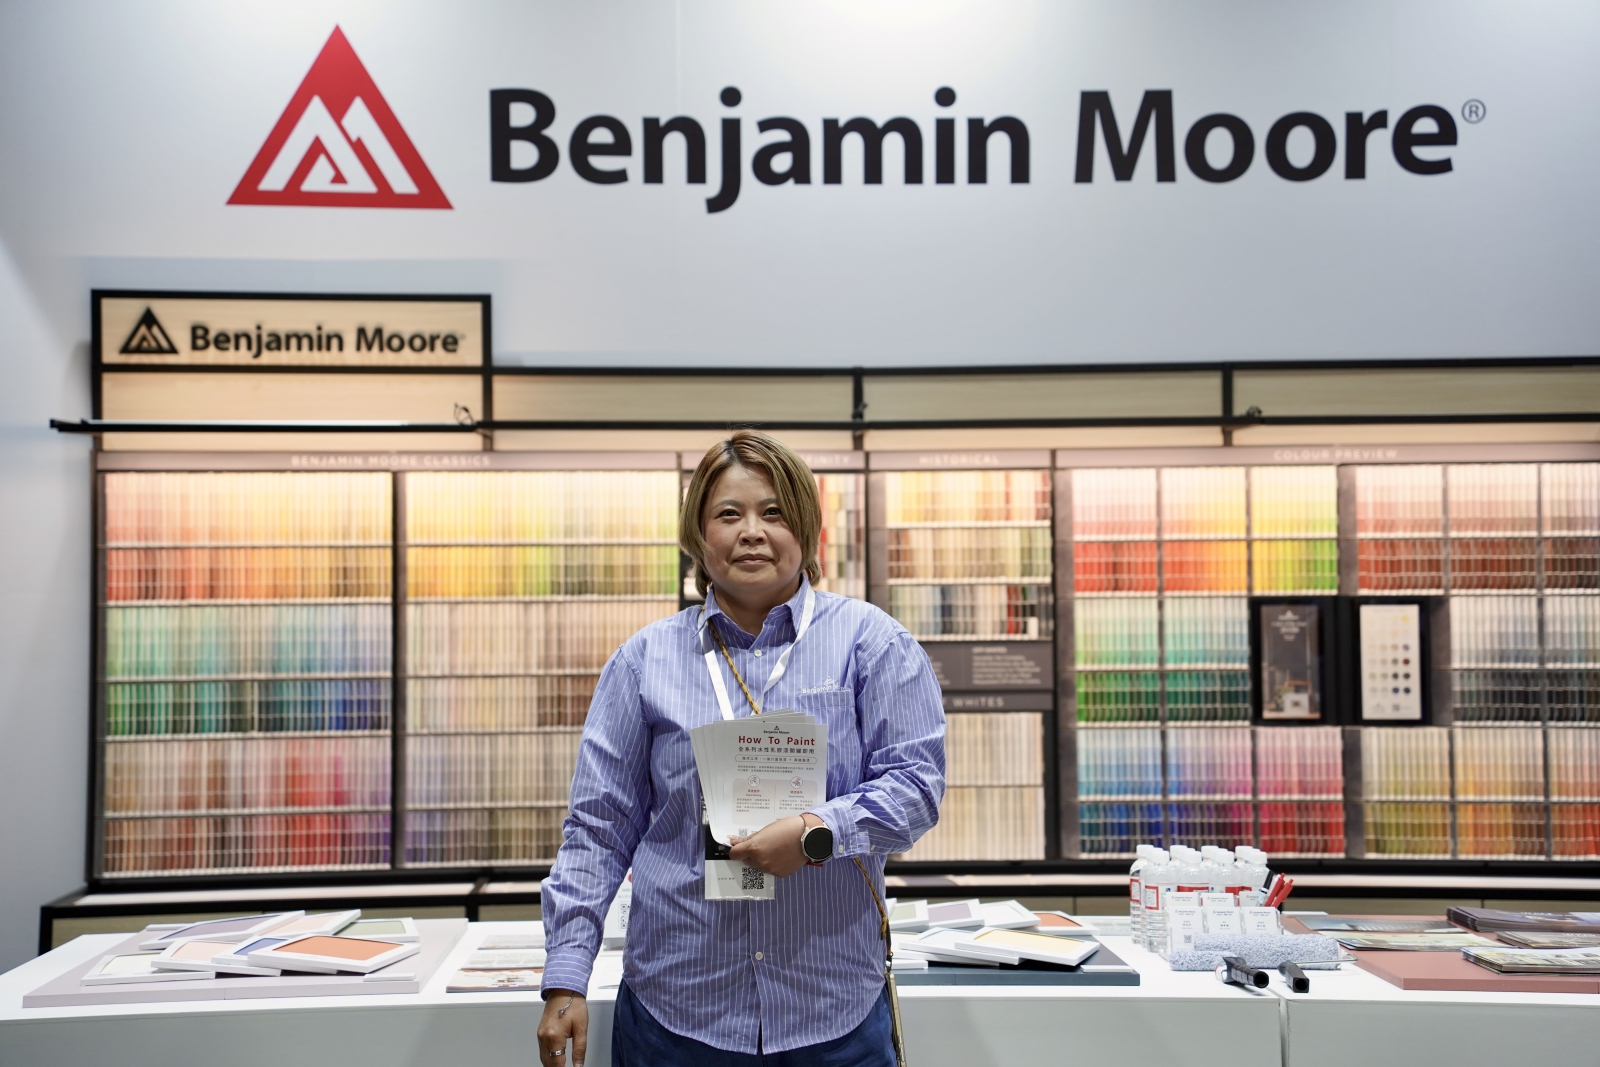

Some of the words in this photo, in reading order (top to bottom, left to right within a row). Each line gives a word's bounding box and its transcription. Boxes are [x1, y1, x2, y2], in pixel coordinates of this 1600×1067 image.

[489, 86, 1031, 214] Benjamin
[190, 324, 344, 359] Benjamin
[355, 326, 459, 353] Moore
[291, 454, 363, 467] BENJAMIN
[368, 454, 417, 467] MOORE
[423, 454, 491, 467] CLASSICS
[919, 453, 999, 466] HISTORICAL
[1273, 449, 1330, 462] COLOUR
[1334, 448, 1399, 460] PREVIEW
[802, 684, 832, 694] Benjamin
[952, 696, 1005, 708] WHITES
[738, 735, 762, 744] How
[768, 736, 780, 745] To
[787, 736, 815, 746] Paint
